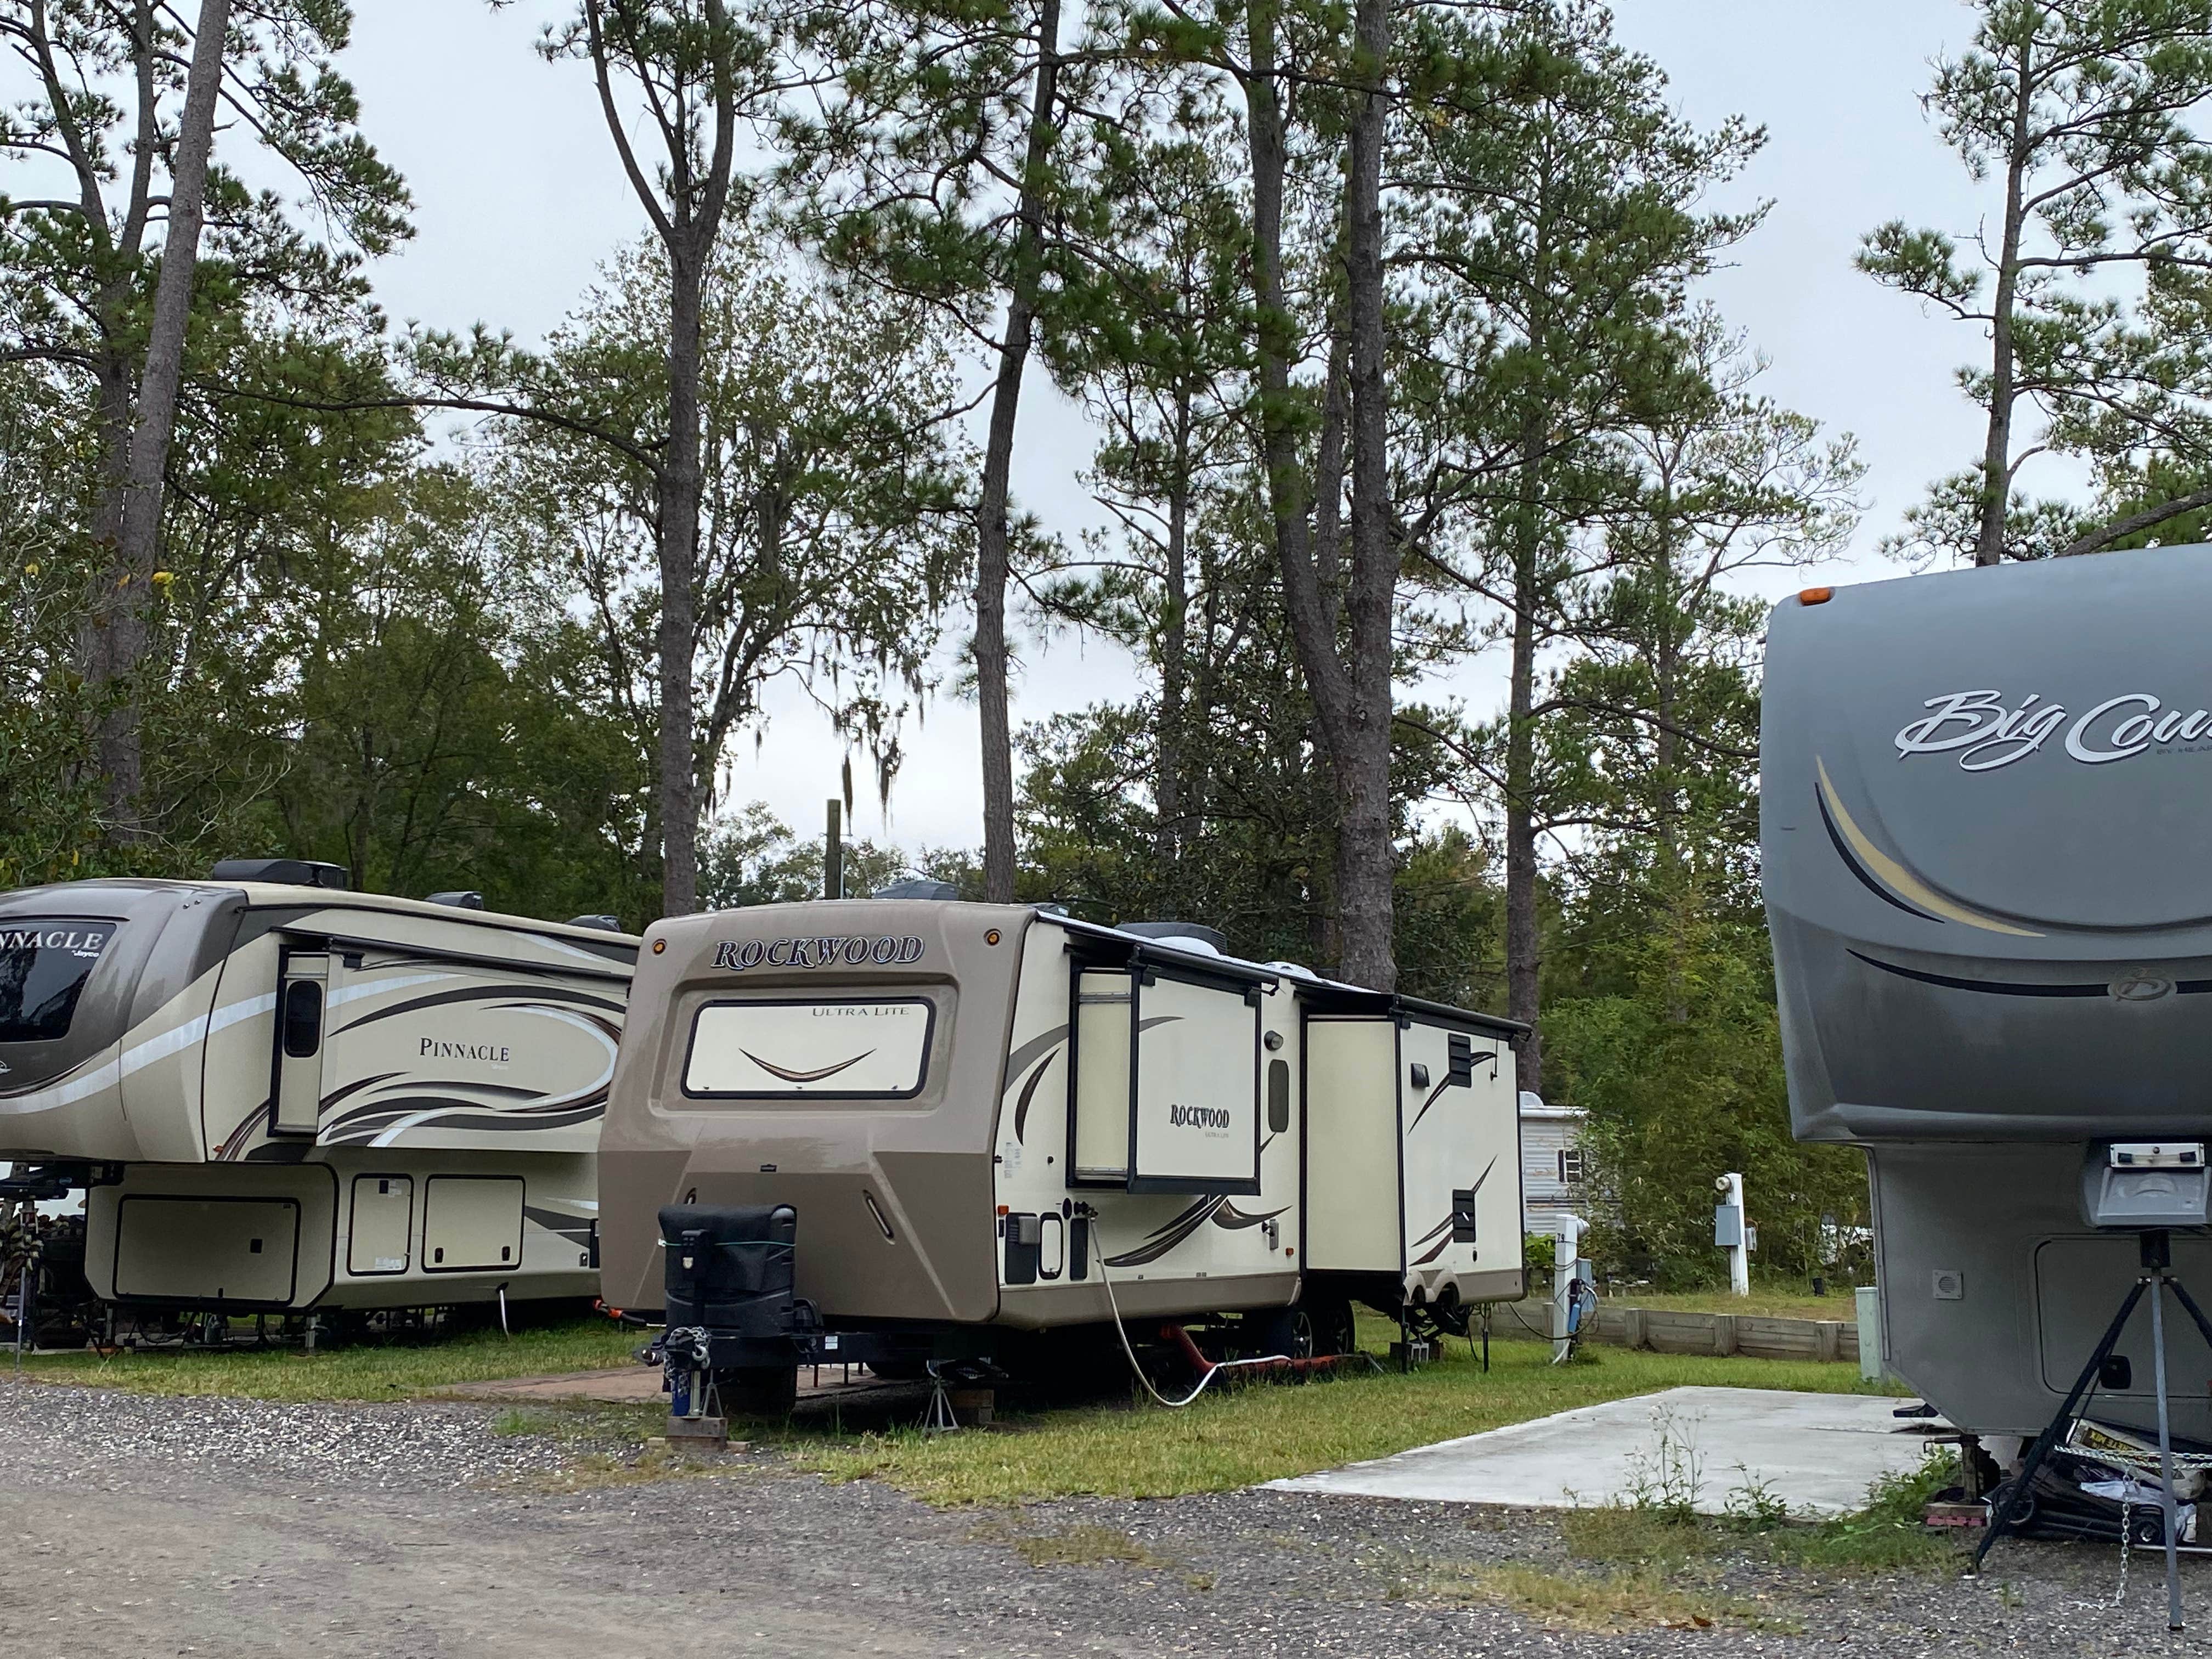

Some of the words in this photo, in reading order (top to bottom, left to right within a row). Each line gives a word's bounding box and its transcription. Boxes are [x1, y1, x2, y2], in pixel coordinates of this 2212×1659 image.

[1894, 690, 2067, 771] Big
[2065, 693, 2212, 764] Cou
[711, 935, 925, 971] ROCKWOOD
[812, 1008, 868, 1017] ULTRA
[874, 1007, 909, 1016] LITE
[420, 1037, 509, 1062] PINNACLE
[1170, 1104, 1229, 1129] ROCKWOOD
